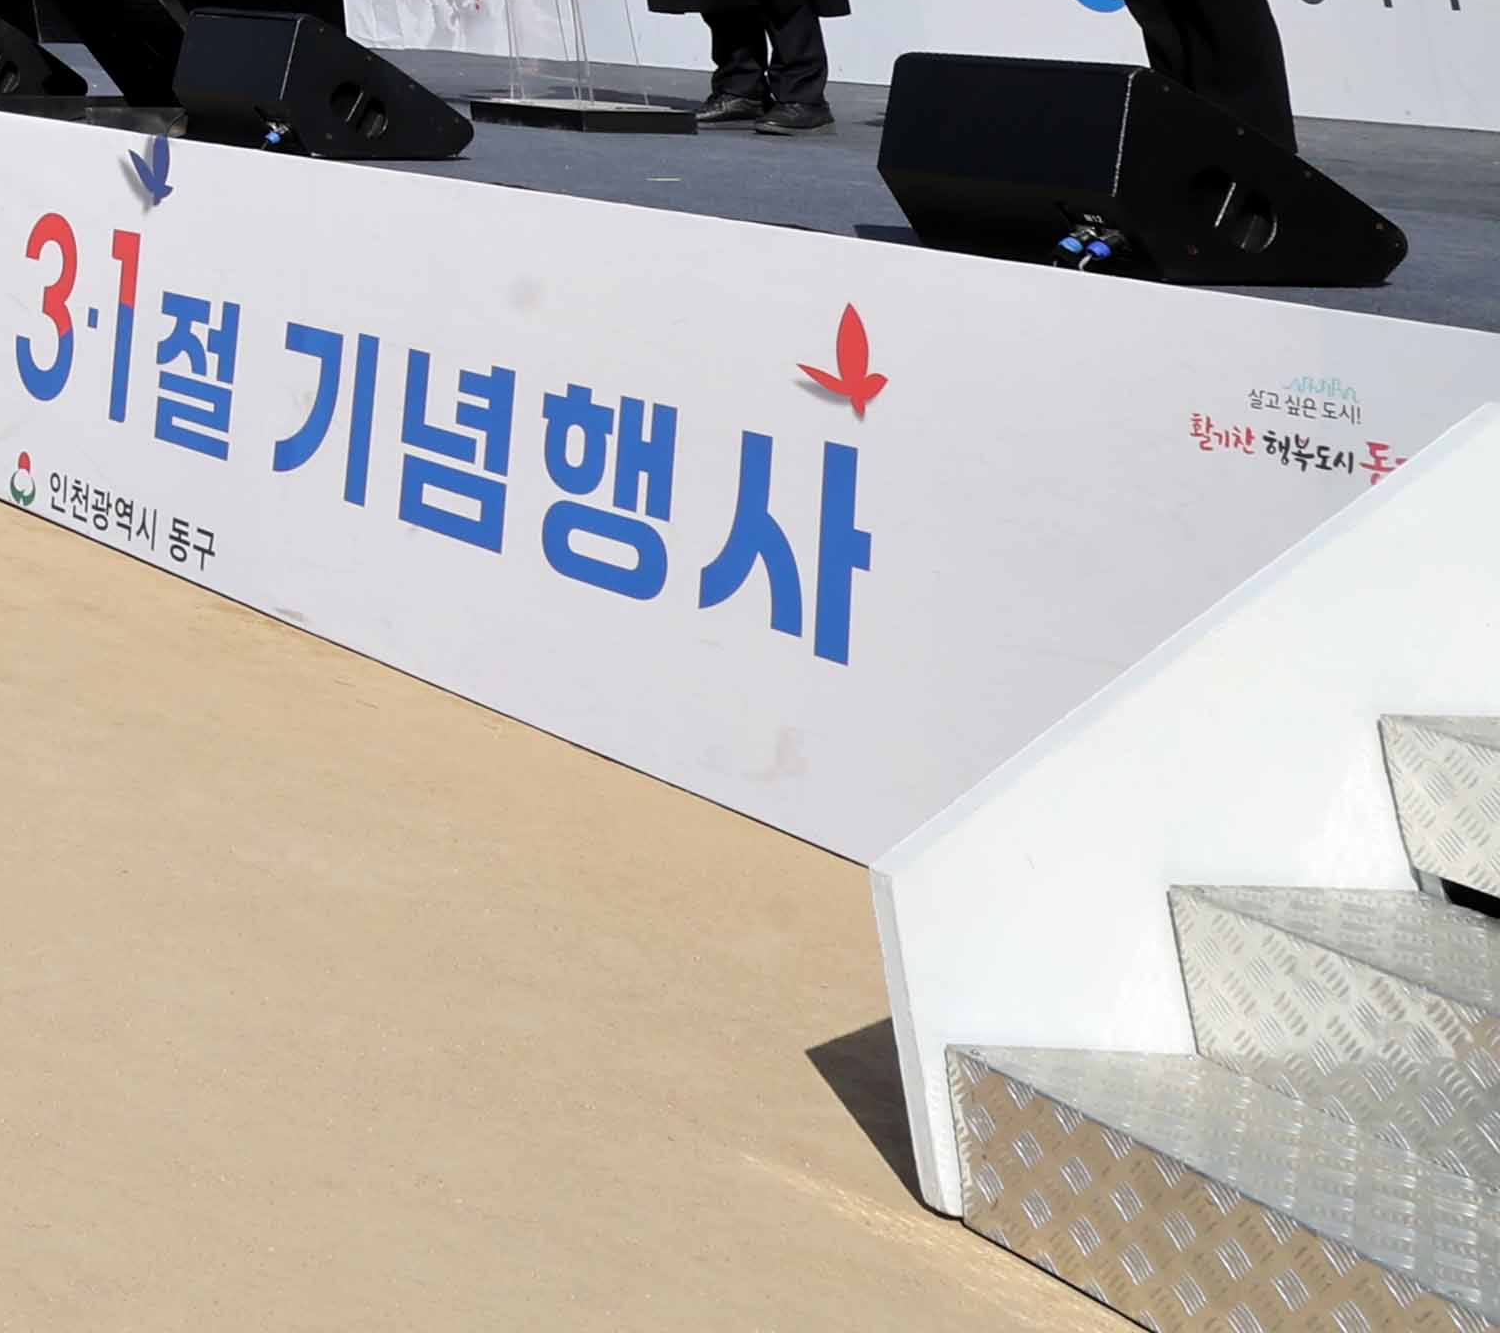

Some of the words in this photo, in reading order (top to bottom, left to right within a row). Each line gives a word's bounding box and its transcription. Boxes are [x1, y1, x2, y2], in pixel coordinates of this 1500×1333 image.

[1190, 413, 1255, 454] 활기찬
[1263, 430, 1354, 474] 행복도시
[1359, 441, 1407, 485] 동
[1248, 389, 1281, 410] 살고
[1285, 395, 1317, 419] 싶은
[1322, 401, 1362, 425] 도시!
[50, 471, 158, 551] 인천광역시
[169, 517, 215, 570] 동구
[272, 321, 872, 666] 기념행사
